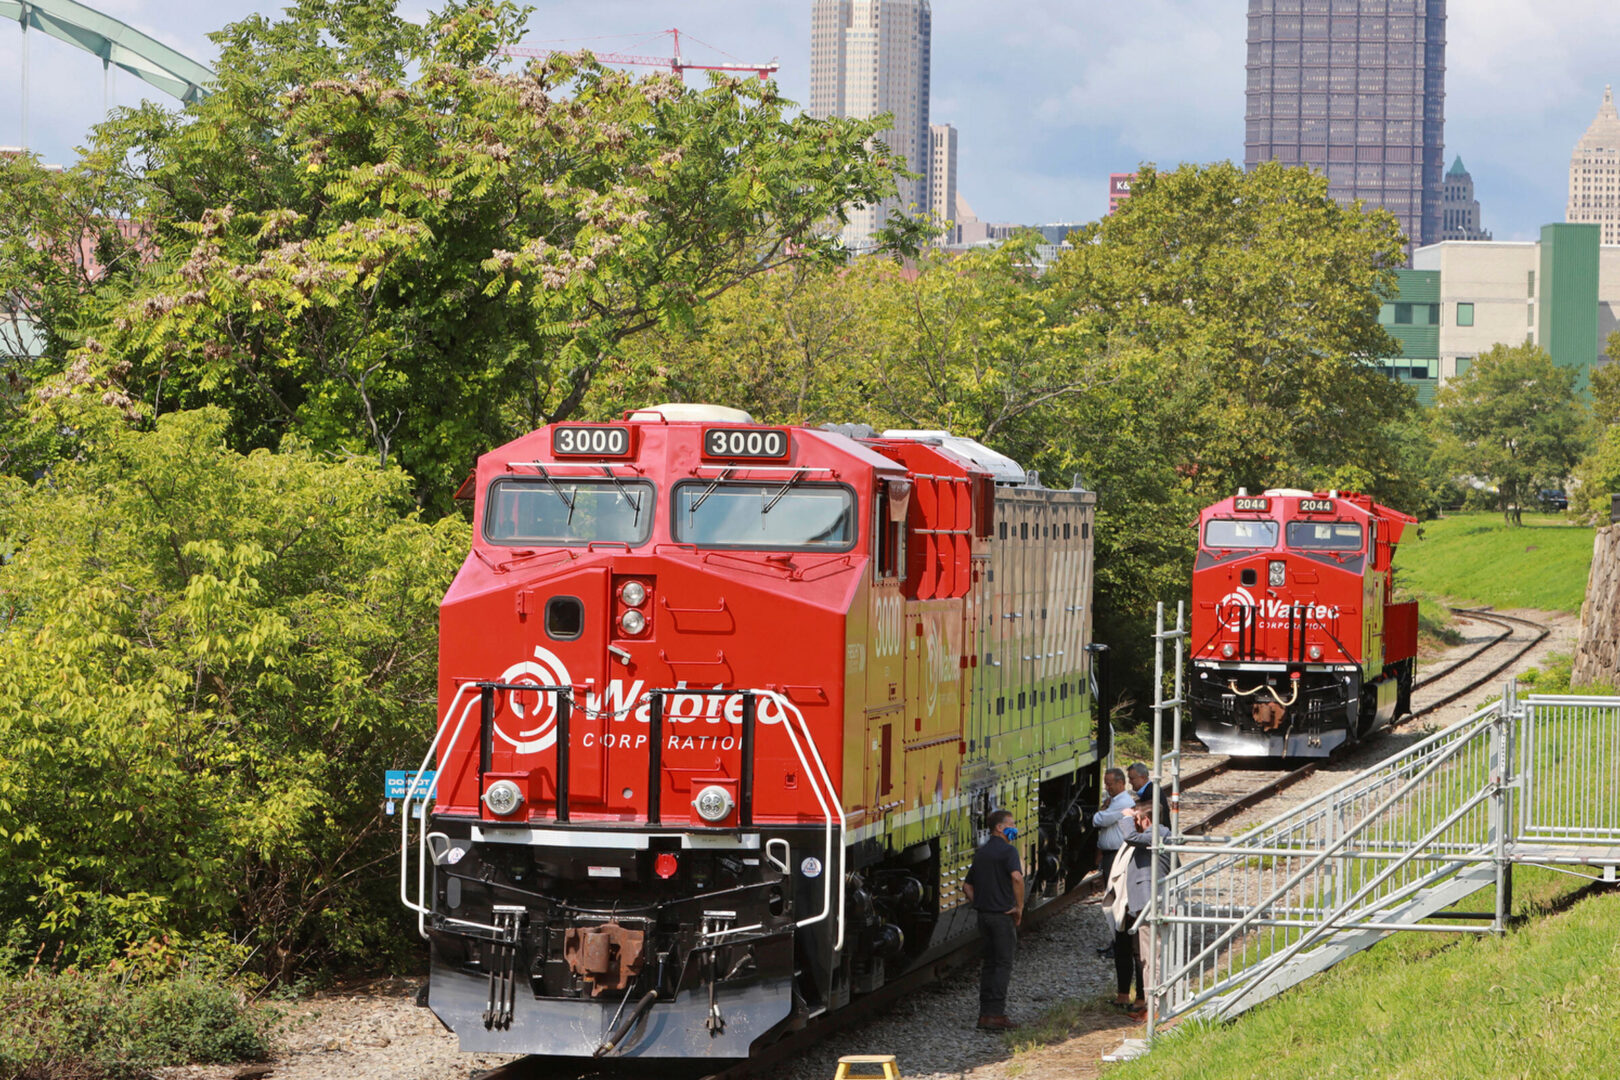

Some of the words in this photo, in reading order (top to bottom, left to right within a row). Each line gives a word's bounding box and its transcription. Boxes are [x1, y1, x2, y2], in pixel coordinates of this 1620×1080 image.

[560, 429, 623, 452] 3000
[712, 431, 780, 454] 3000
[1237, 499, 1266, 510] 2044
[1301, 501, 1331, 511] 2044
[1259, 599, 1340, 619] Wabtec
[875, 596, 900, 658] 3000
[585, 677, 789, 724] Wabtec
[582, 732, 743, 750] CORPRATIO
